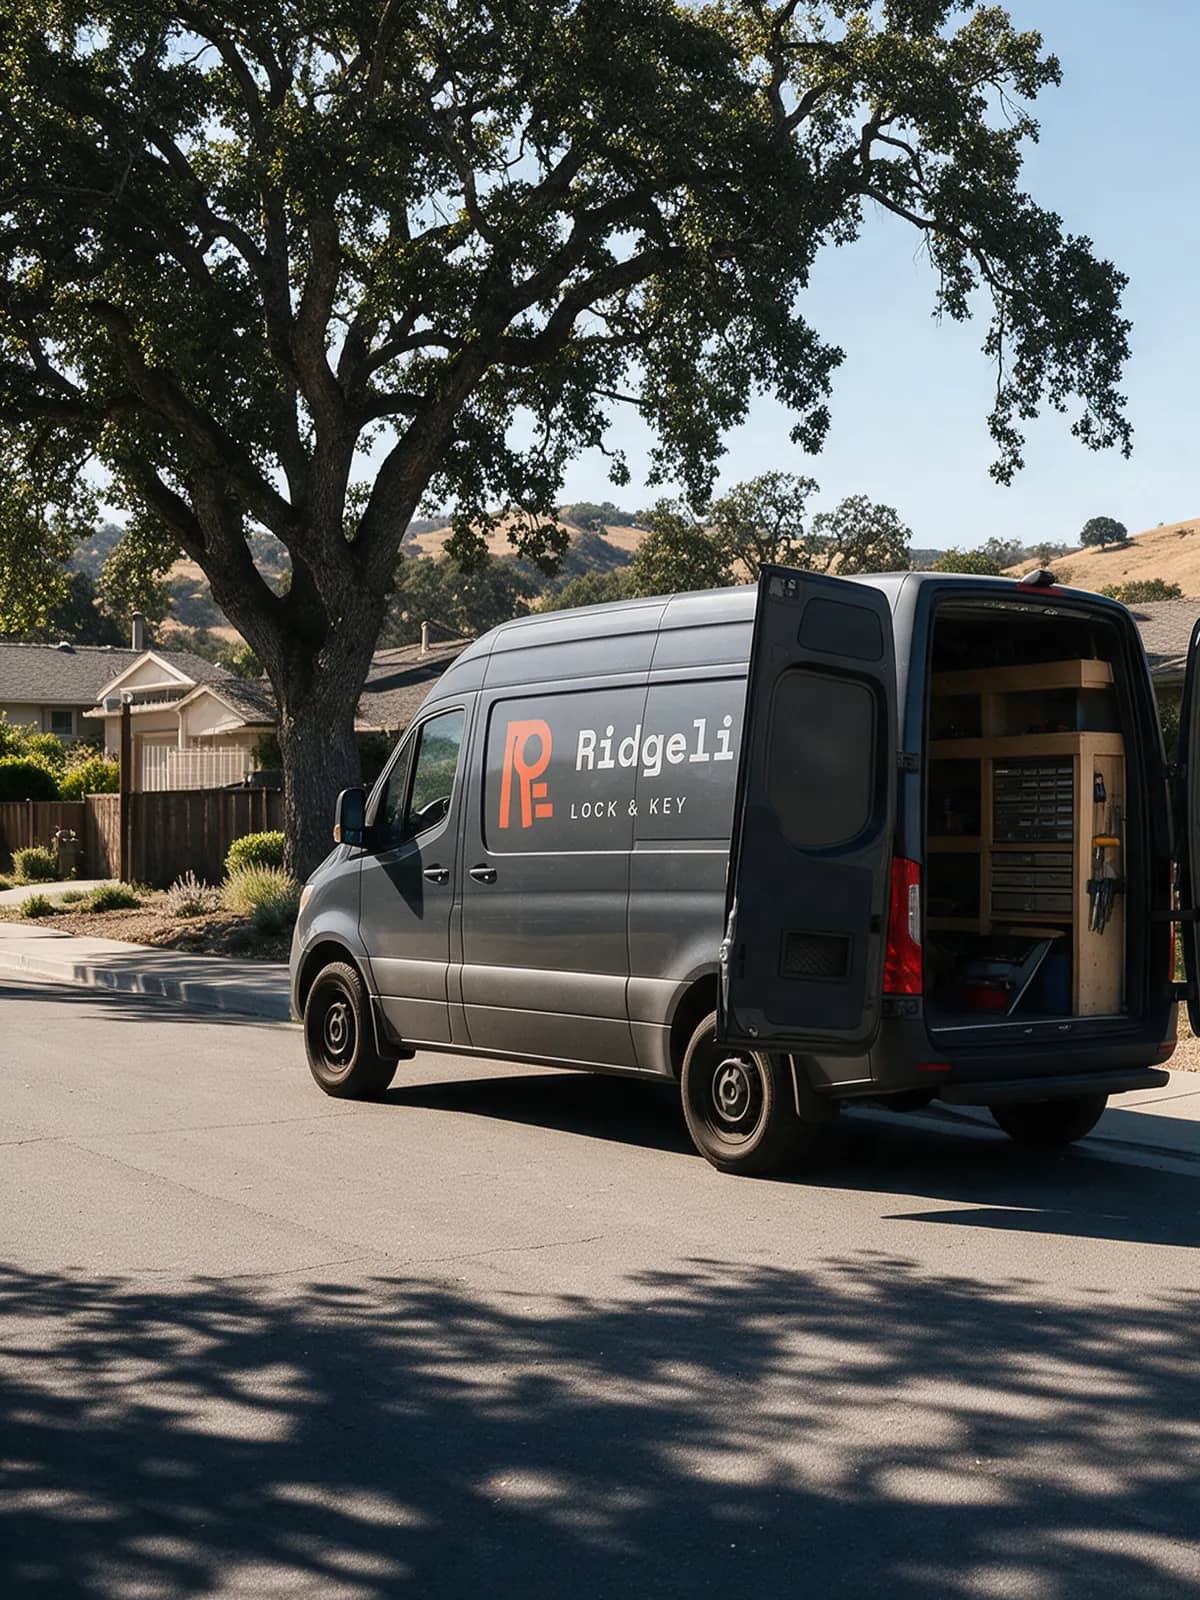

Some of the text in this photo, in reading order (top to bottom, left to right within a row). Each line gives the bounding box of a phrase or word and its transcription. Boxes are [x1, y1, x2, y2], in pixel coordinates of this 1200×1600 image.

[570, 797, 687, 819] LOCK & KEY
